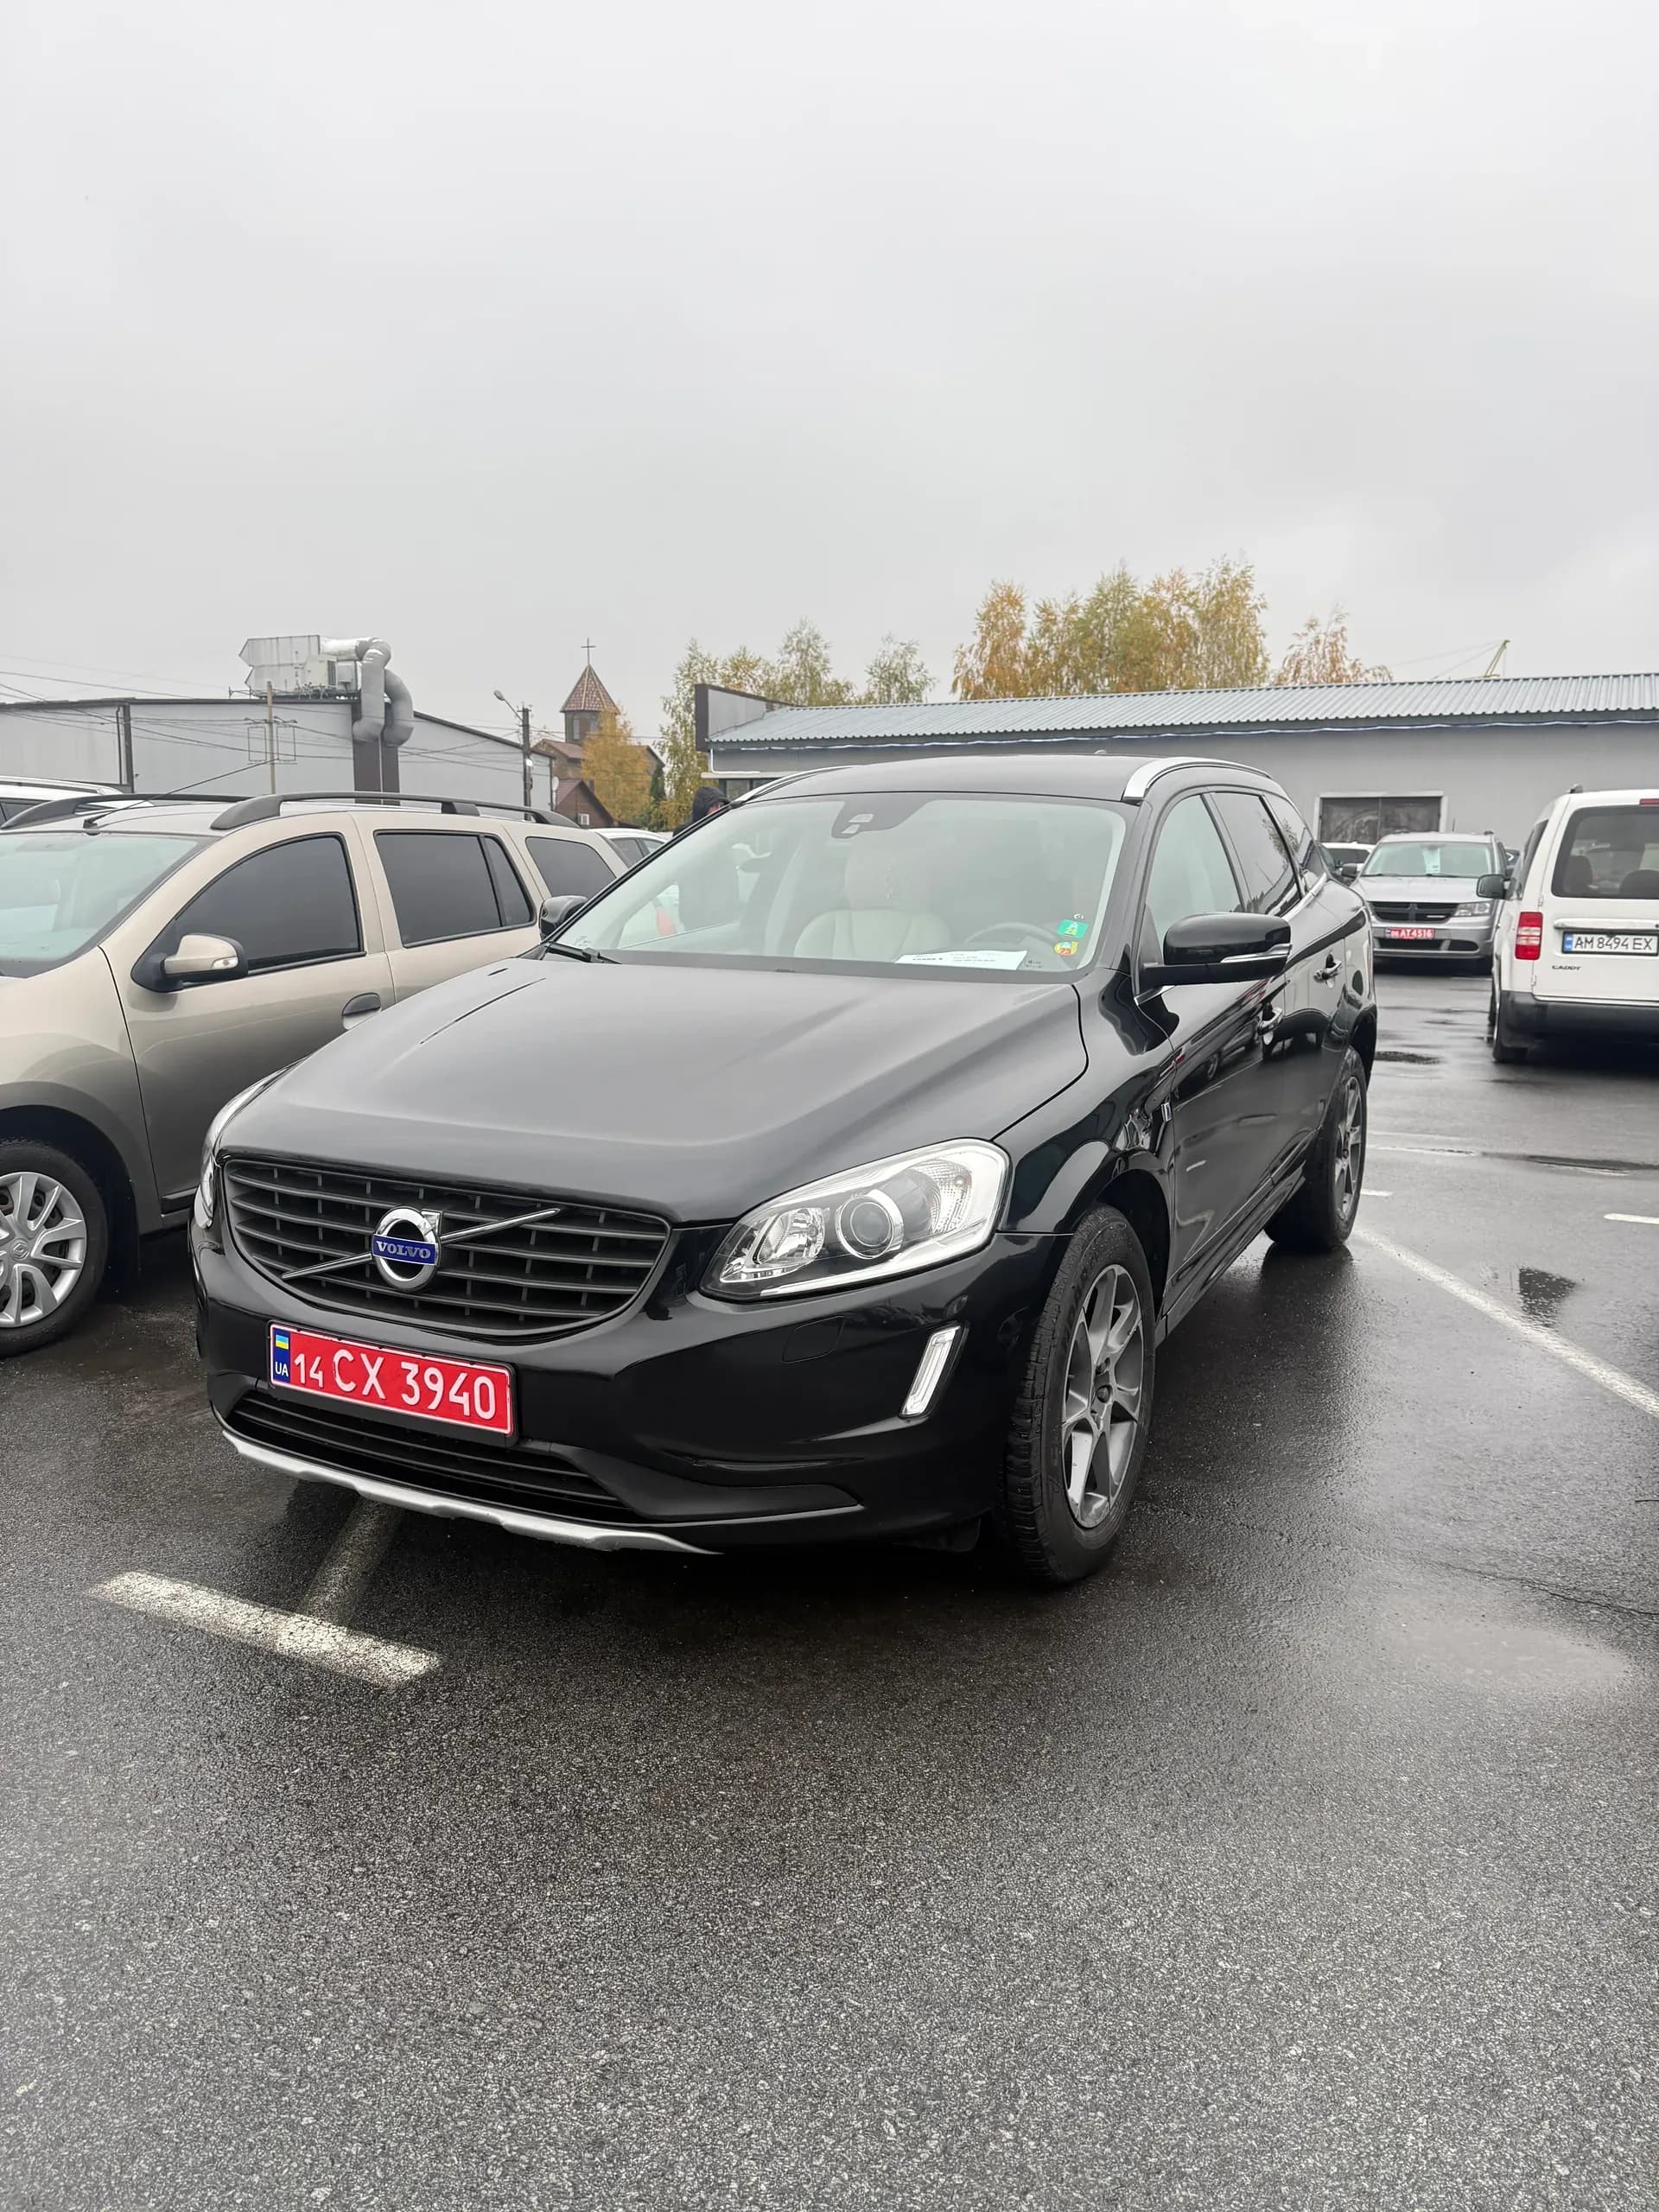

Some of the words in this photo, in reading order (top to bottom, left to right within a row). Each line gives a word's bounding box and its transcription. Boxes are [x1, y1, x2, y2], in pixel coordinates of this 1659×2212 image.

[1574, 937, 1594, 949] AM
[1597, 937, 1629, 950] 8494
[1632, 938, 1653, 950] EX
[376, 1240, 431, 1259] VOLVO
[275, 1361, 289, 1377] UA
[294, 1353, 324, 1388] 14
[333, 1349, 386, 1399] CX
[401, 1361, 496, 1420] 3940
